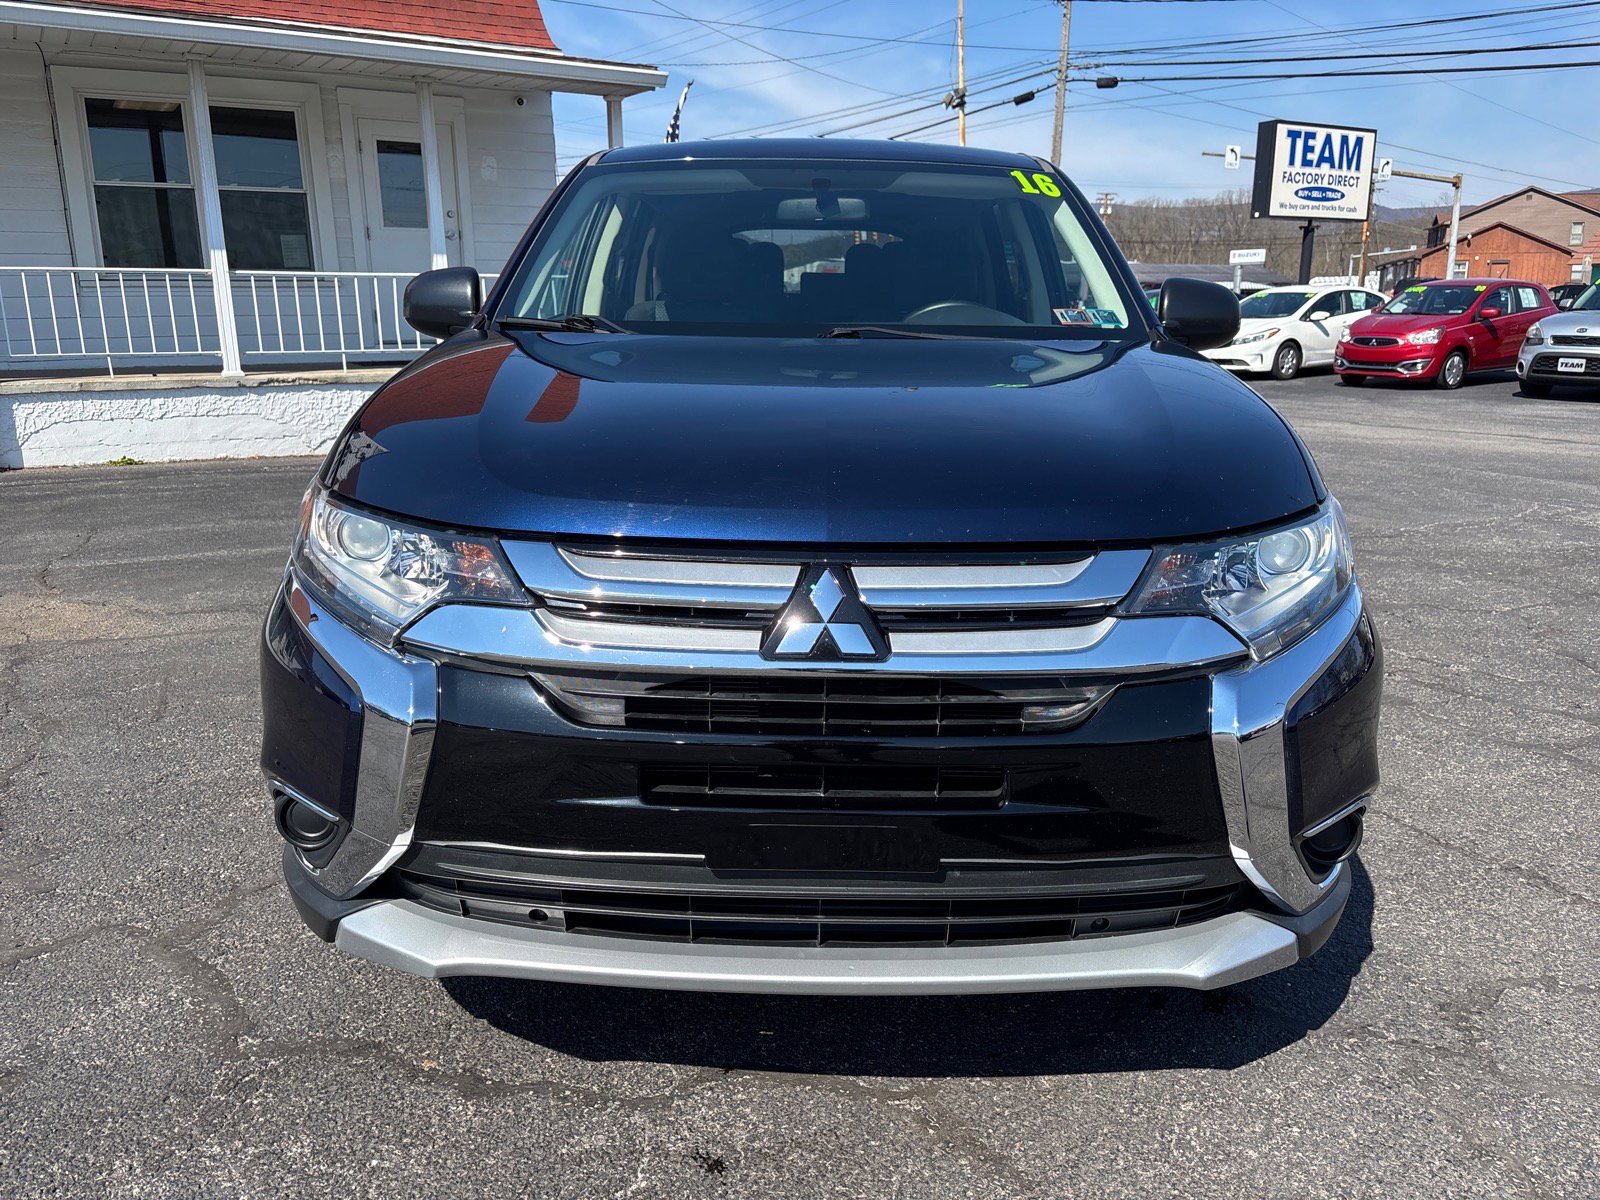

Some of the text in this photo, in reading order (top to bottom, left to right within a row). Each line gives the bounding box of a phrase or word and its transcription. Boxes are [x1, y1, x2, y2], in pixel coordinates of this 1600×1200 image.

[1286, 129, 1364, 172] TEAM
[1010, 170, 1062, 198] 16
[1282, 171, 1360, 188] FACTORY DIRECT
[1298, 189, 1342, 200] BUY SELL TRADE
[1288, 203, 1298, 211] buy
[1321, 204, 1336, 212] trucks
[1559, 361, 1584, 369] TEAM
